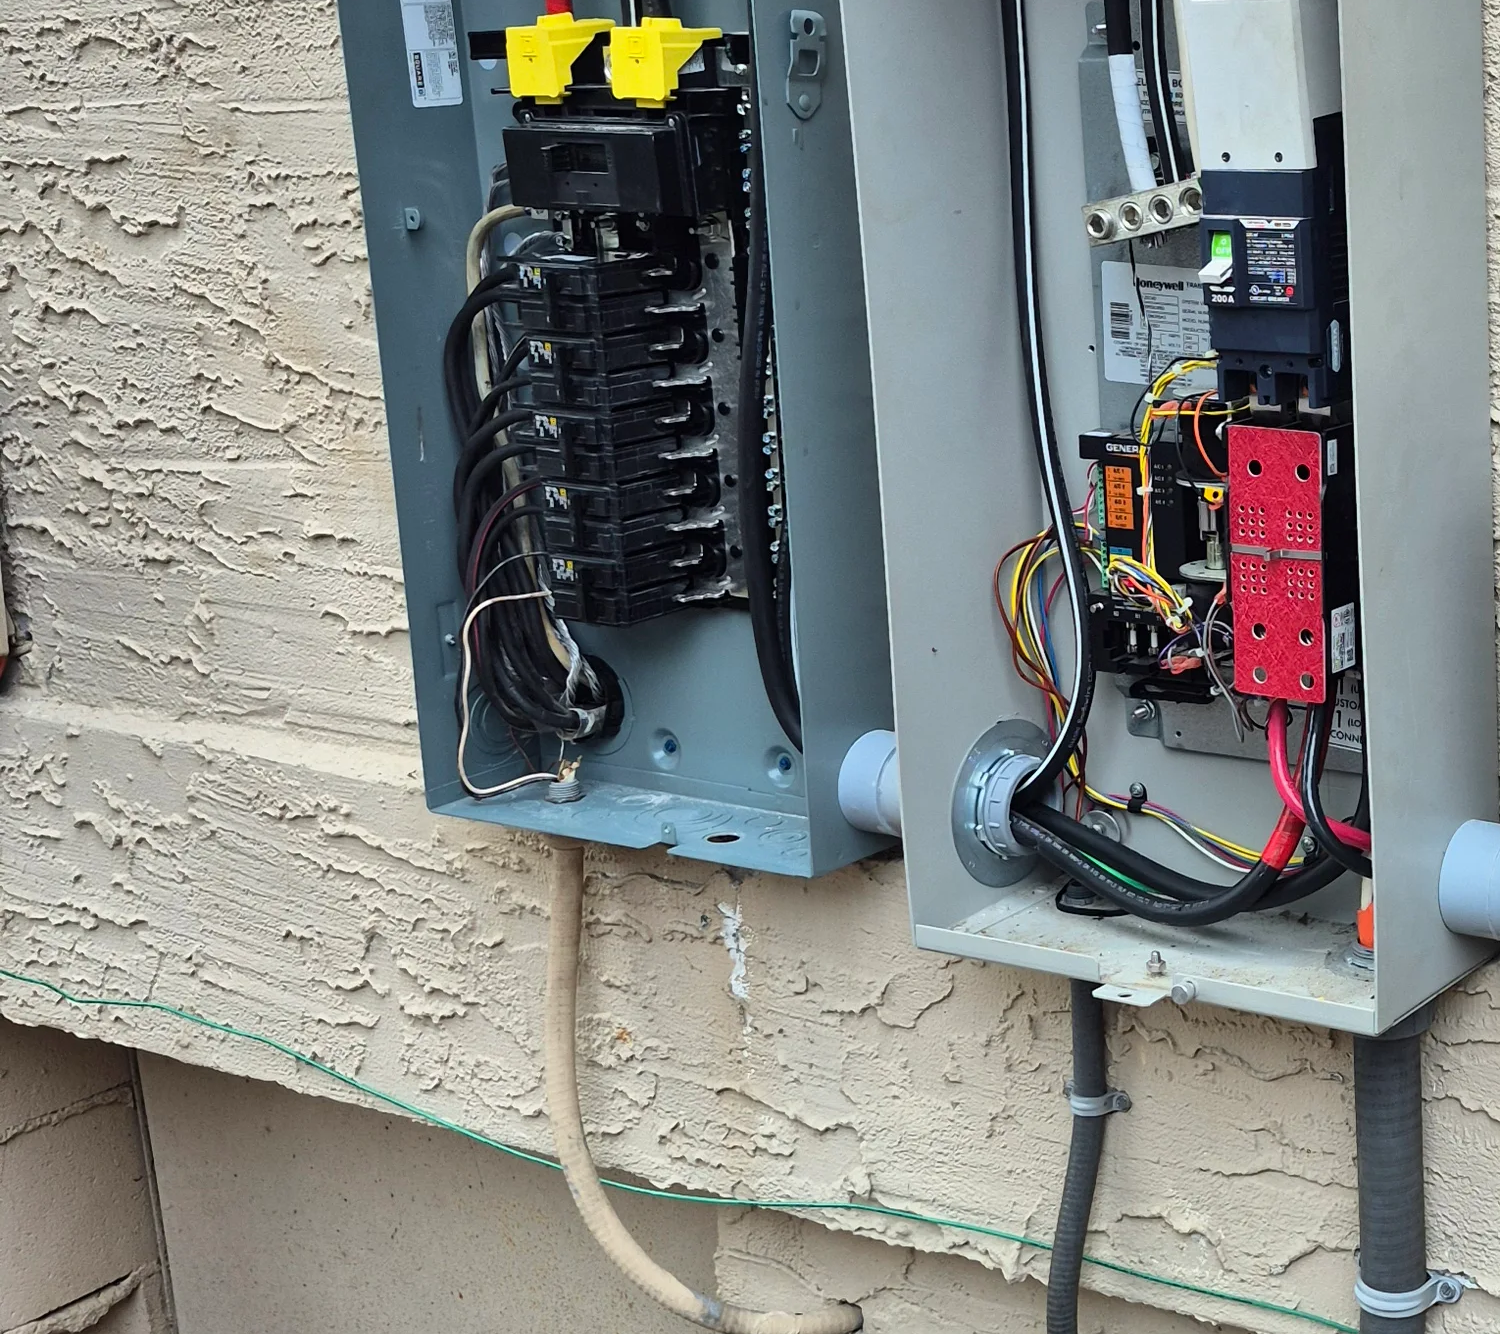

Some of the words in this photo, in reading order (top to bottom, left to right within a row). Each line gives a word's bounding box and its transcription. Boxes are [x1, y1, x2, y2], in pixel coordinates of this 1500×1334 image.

[413, 53, 425, 88] SQUARE
[1211, 294, 1234, 303] 200A
[1105, 443, 1151, 454] GENER
[1335, 698, 1360, 711] USTO
